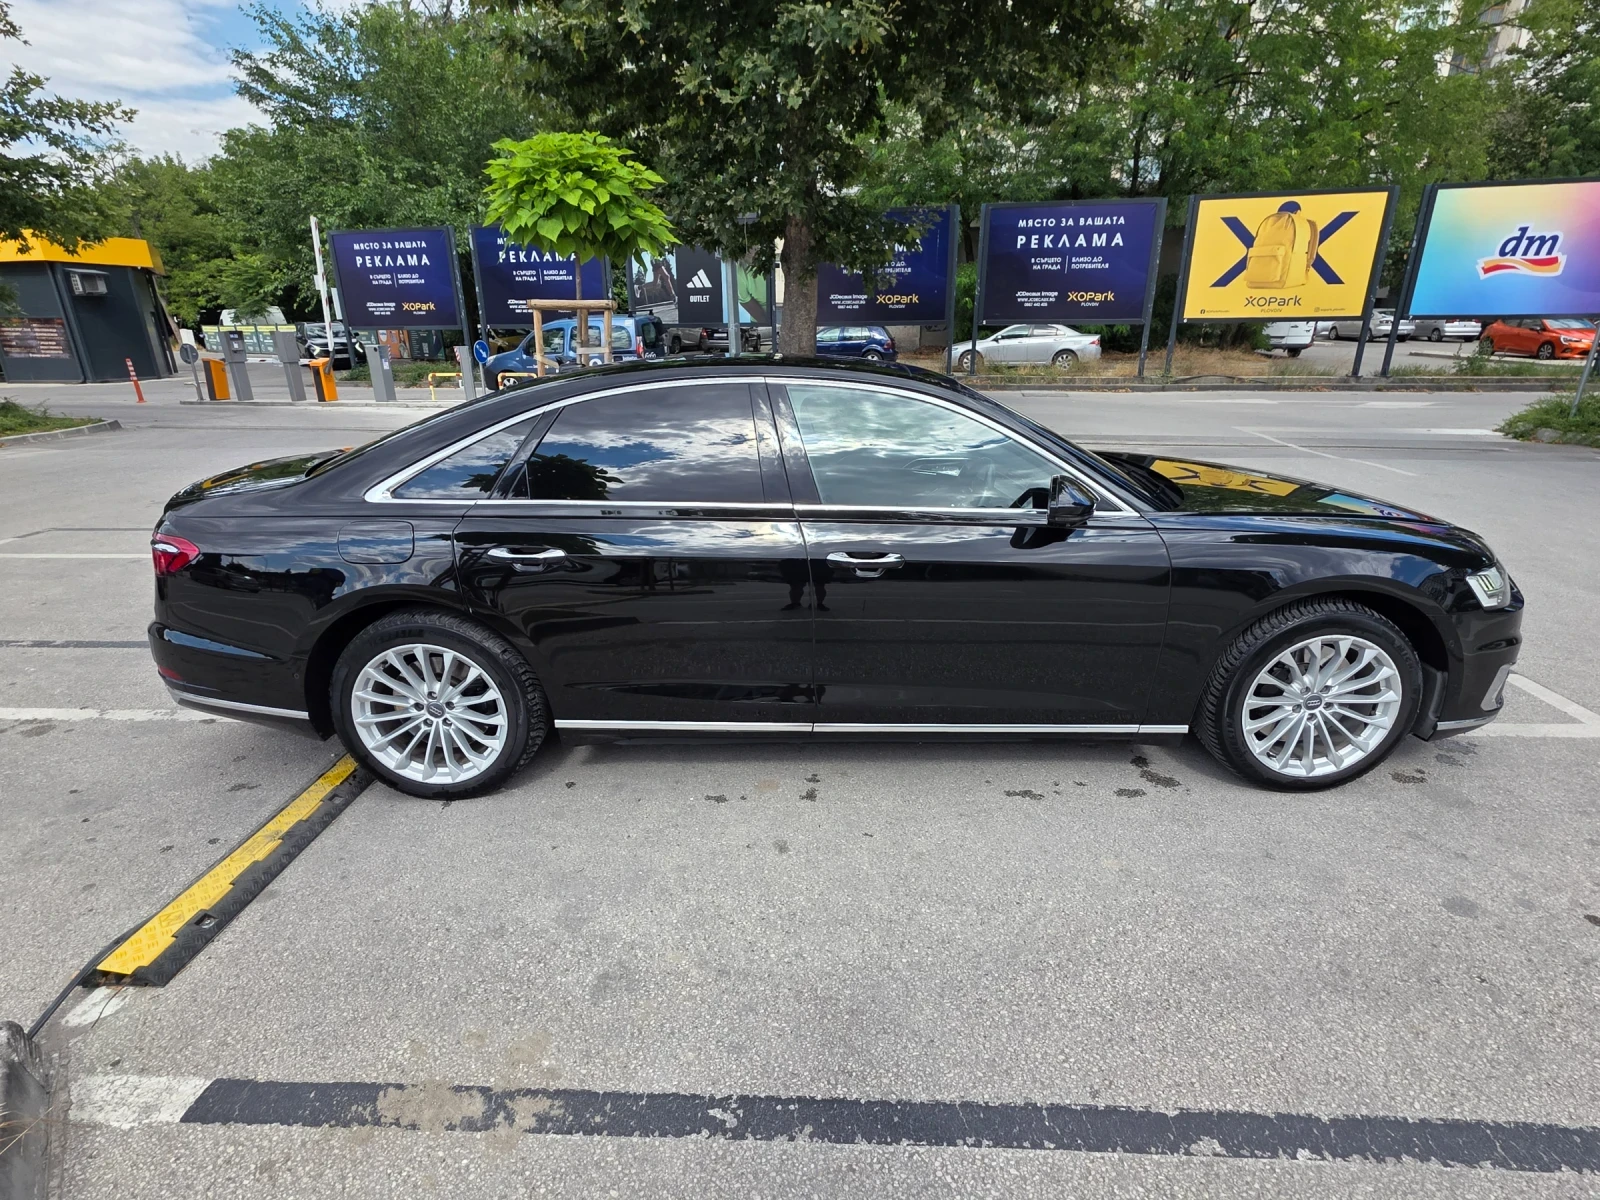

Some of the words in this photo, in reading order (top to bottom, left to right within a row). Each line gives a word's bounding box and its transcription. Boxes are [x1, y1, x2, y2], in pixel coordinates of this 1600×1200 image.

[1018, 219, 1055, 227] МЯСТО
[1060, 218, 1074, 226] ЗА
[1079, 216, 1125, 226] ВАШАТА
[354, 242, 380, 250] МЯСТО
[395, 240, 427, 249] ВАШАТА
[1017, 232, 1124, 248] РЕКЛАМА
[1499, 226, 1559, 257] dm
[355, 254, 430, 268] РЕКЛАМА
[876, 294, 919, 304] XOPark
[1067, 291, 1114, 302] XOPark
[1244, 295, 1302, 307] XOPark
[402, 301, 436, 311] XOPark
